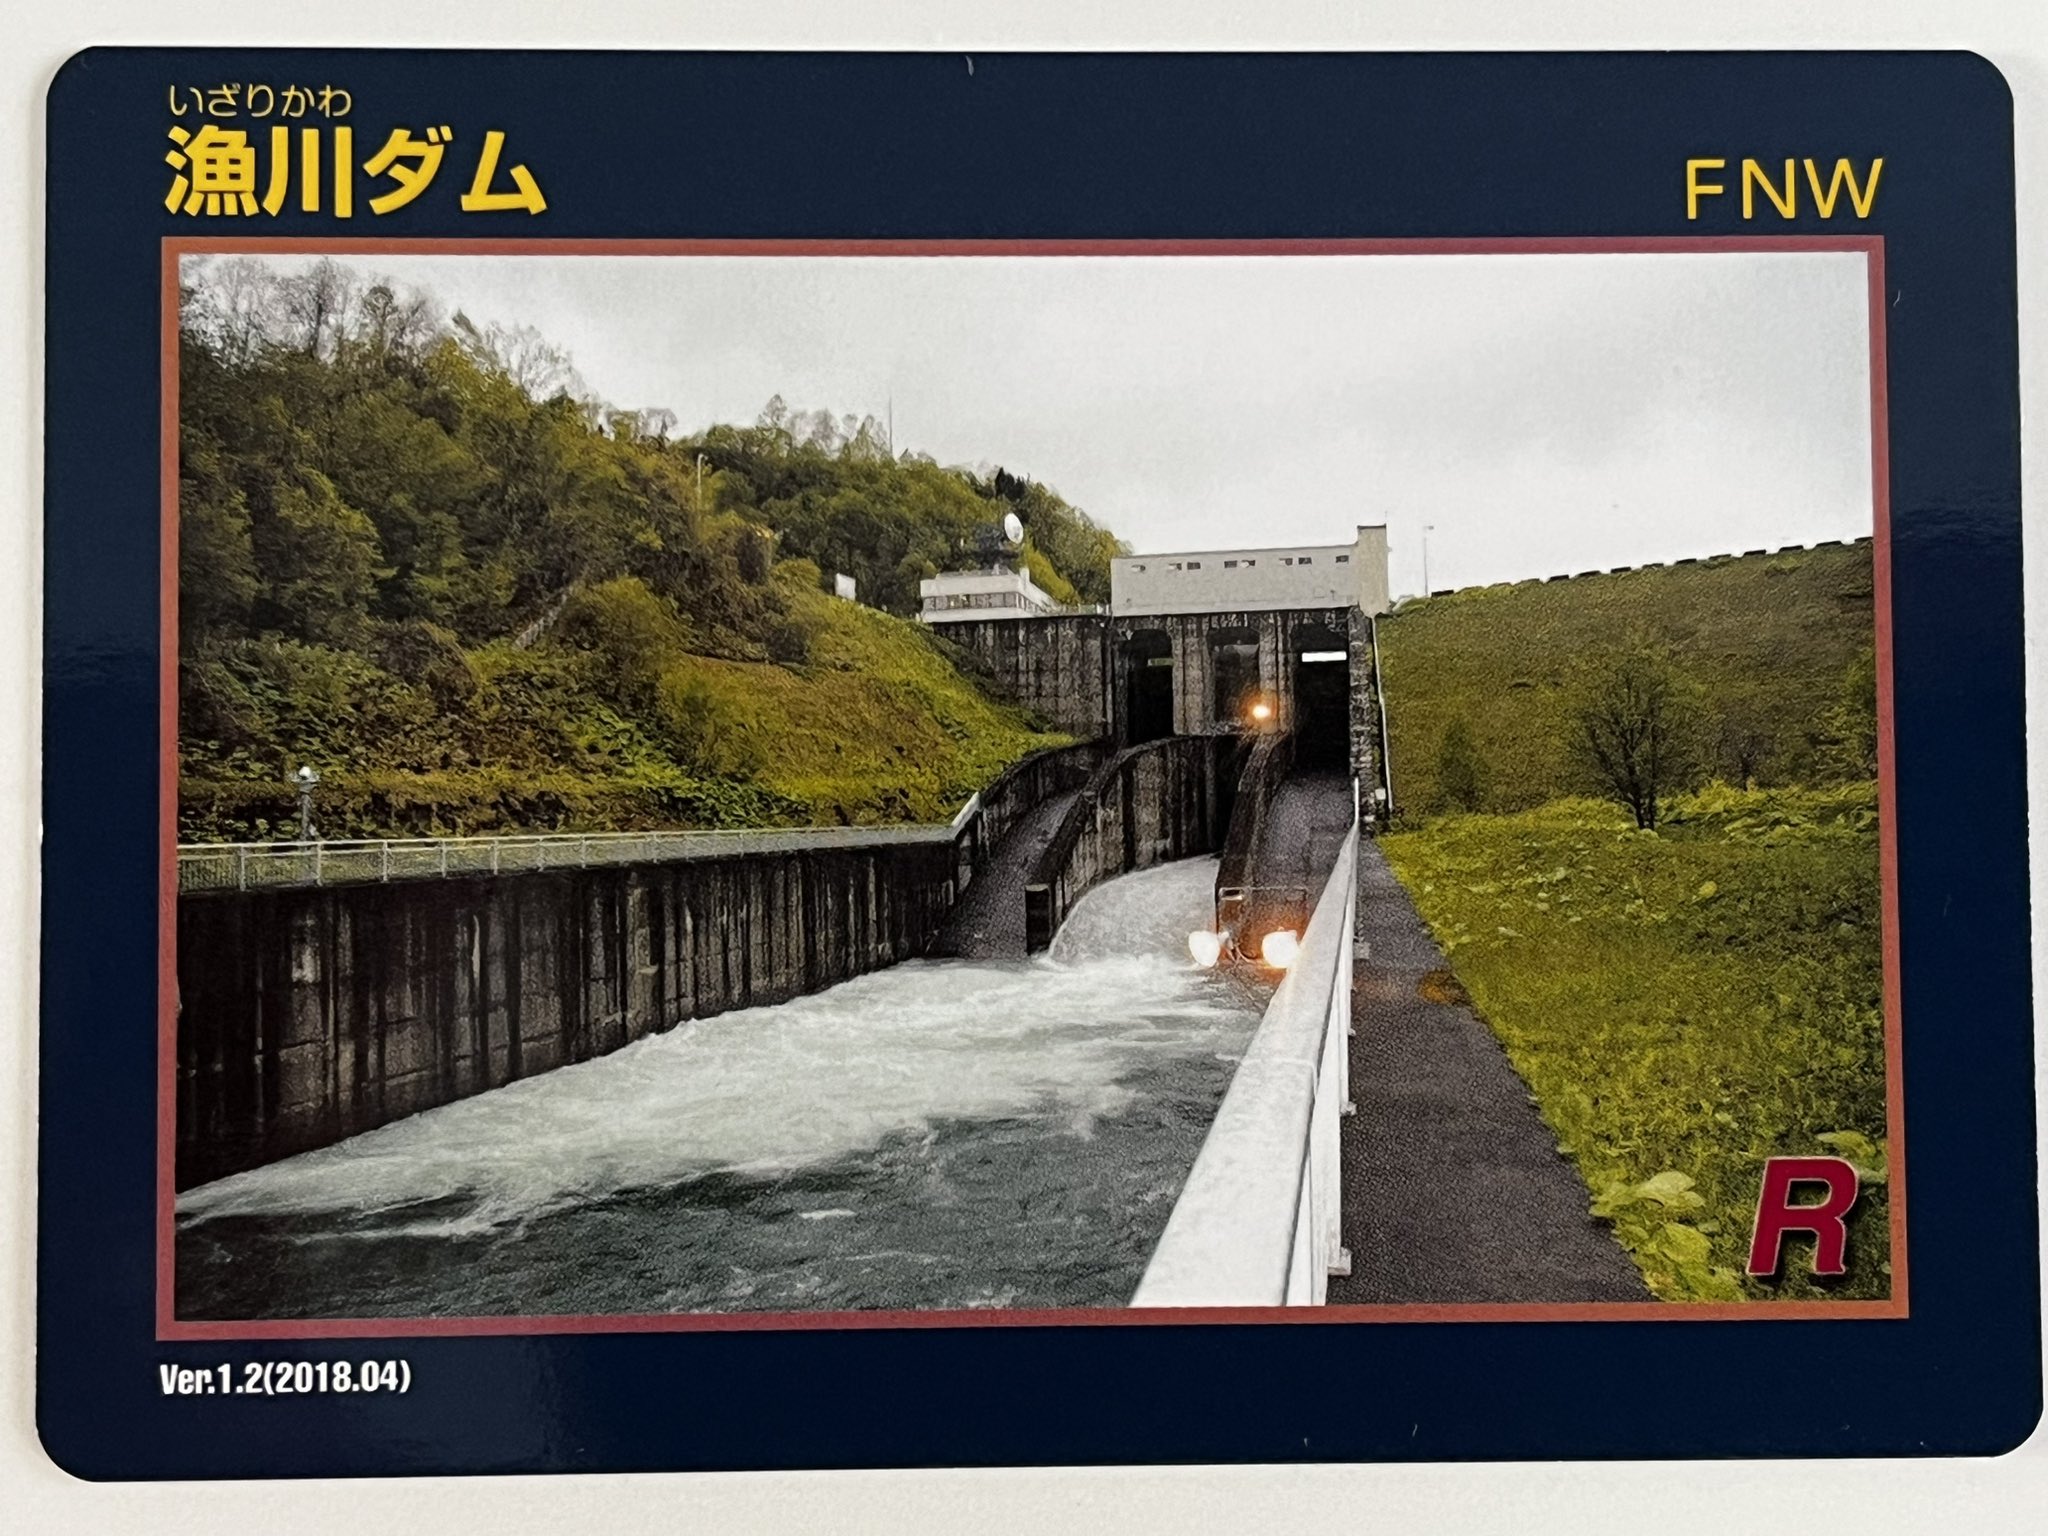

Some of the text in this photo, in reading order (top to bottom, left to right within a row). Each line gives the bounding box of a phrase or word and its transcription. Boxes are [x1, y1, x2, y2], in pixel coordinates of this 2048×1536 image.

[169, 83, 352, 118] いざりかわ
[165, 125, 548, 218] 漁川ダム
[1687, 158, 1884, 220] FNW
[1746, 1156, 1860, 1275] R
[160, 1360, 411, 1395] Ver.1.2(2018.04)
